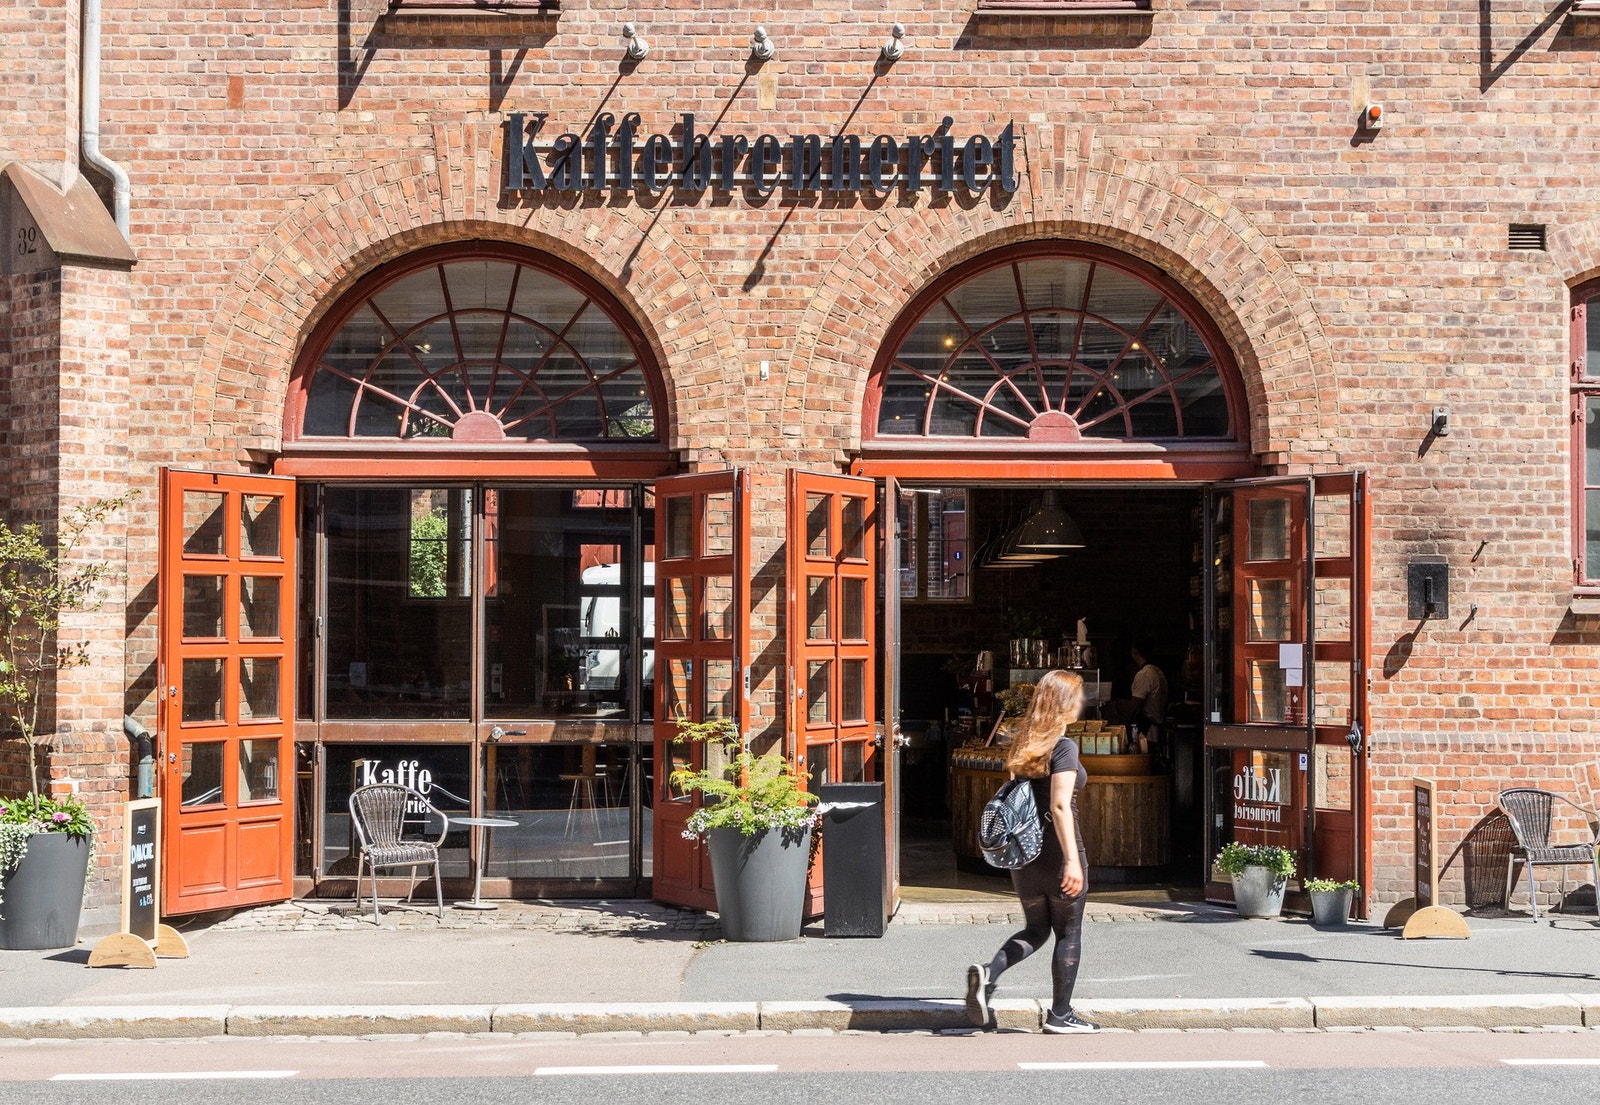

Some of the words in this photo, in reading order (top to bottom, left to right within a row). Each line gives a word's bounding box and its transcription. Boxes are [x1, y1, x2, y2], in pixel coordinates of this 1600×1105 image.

[505, 112, 1022, 193] Kaffebrenneriet
[18, 227, 37, 256] 32
[362, 759, 432, 795] Kaffe
